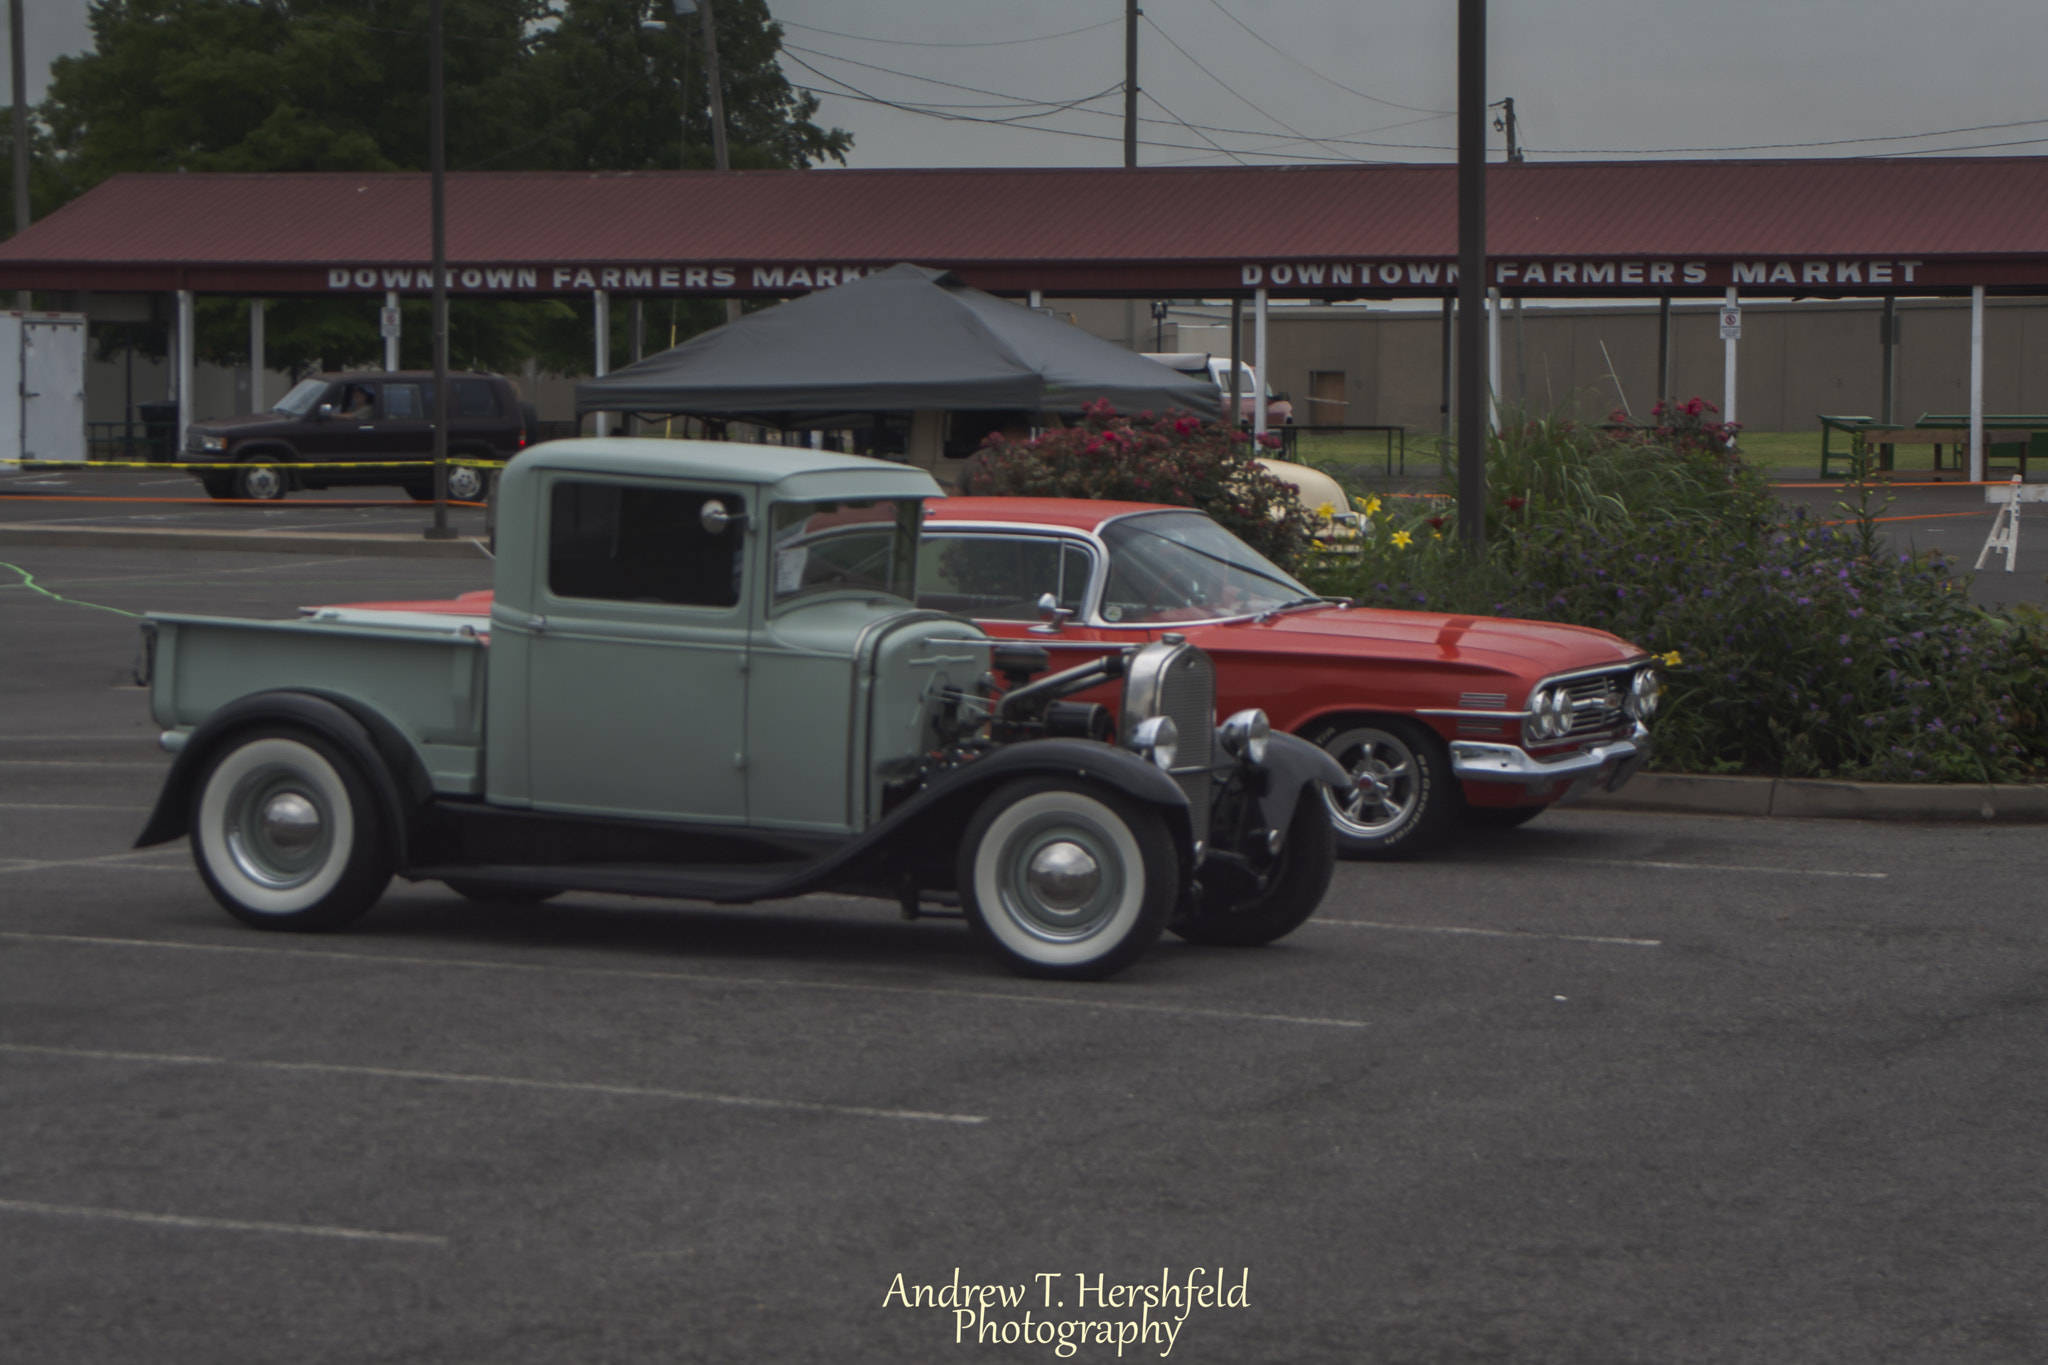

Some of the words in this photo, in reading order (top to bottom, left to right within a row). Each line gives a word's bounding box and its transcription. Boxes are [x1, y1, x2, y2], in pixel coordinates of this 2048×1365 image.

[328, 267, 537, 288] DOWNTOWN
[553, 266, 736, 288] FARMERS
[752, 266, 885, 287] MARK
[1495, 261, 1708, 283] FARMERS
[1732, 261, 1924, 283] MARKET
